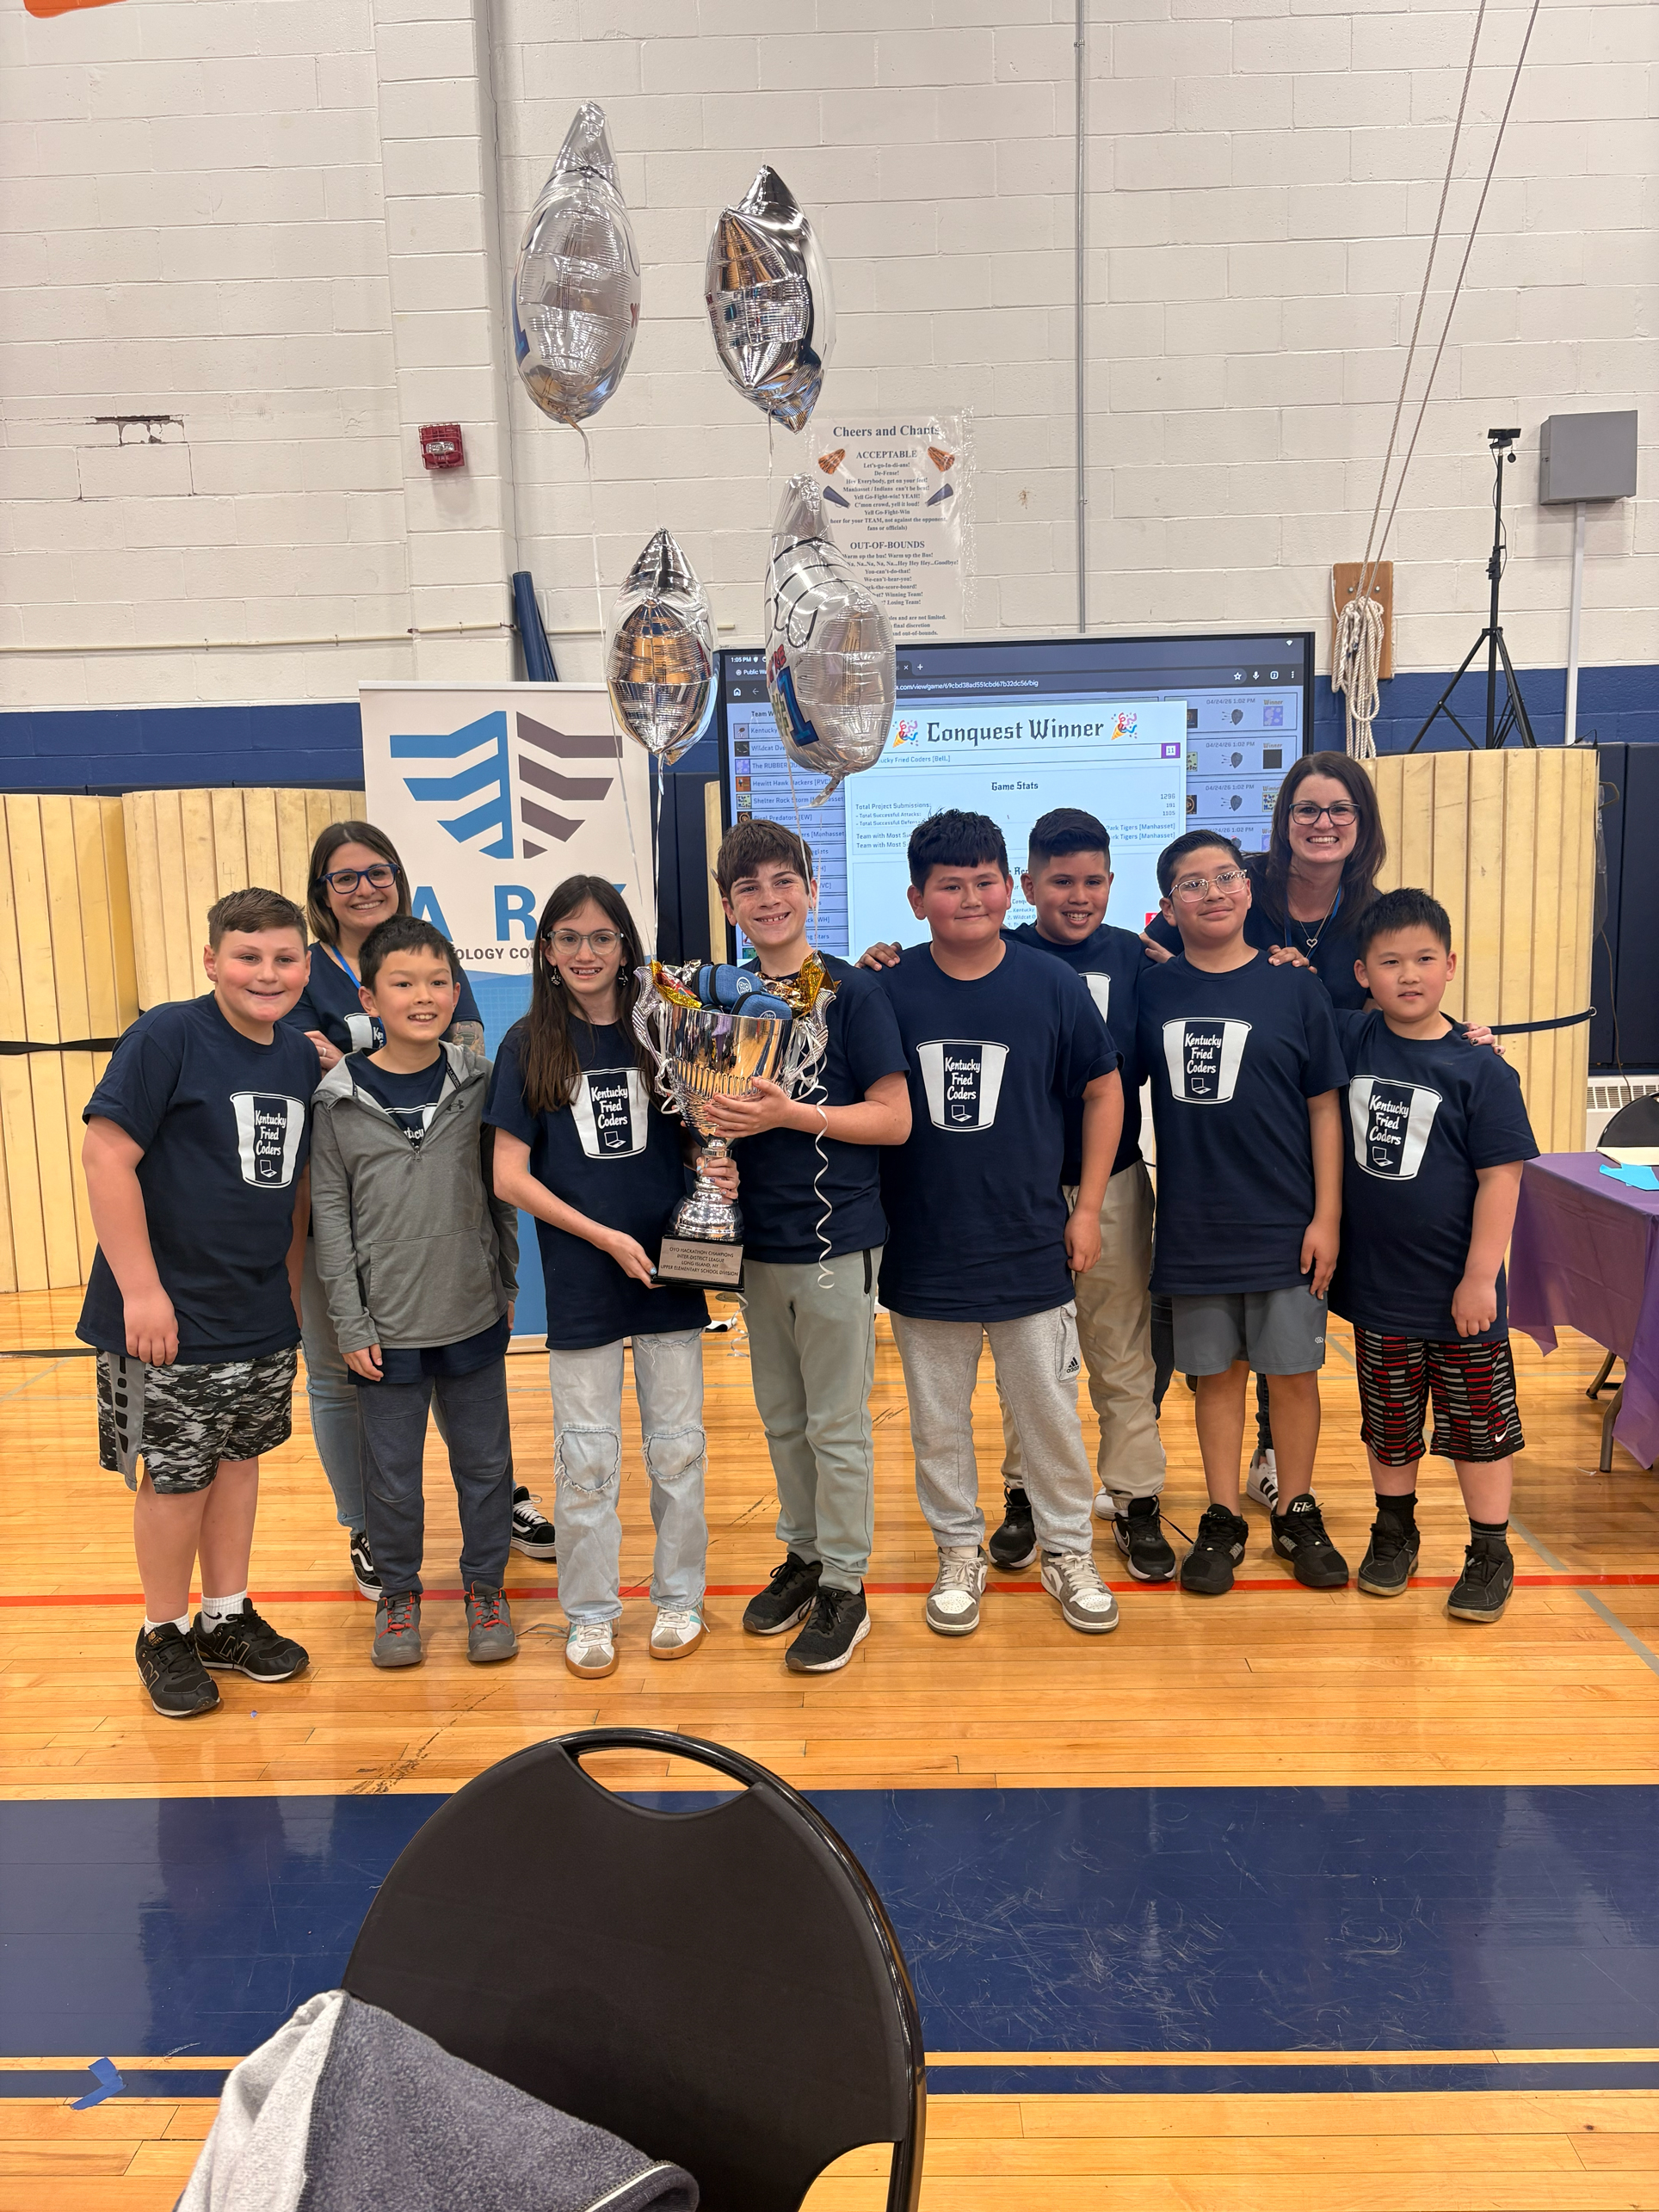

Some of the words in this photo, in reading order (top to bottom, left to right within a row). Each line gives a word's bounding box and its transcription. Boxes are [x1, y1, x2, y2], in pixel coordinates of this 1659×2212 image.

[833, 427, 873, 437] Cheers
[876, 426, 897, 436] and
[900, 425, 940, 435] Chants
[856, 450, 917, 459] ACCEPTABLE
[927, 721, 1023, 746] Conquest
[1029, 718, 1105, 741] Winner
[991, 782, 1015, 792] Game
[1016, 781, 1039, 790] Stats
[1185, 1033, 1222, 1048] Kentucky
[1191, 1047, 1212, 1060] Fried
[945, 1057, 980, 1073] Kentucky
[1187, 1060, 1216, 1074] Coders
[952, 1073, 973, 1085] Fried
[591, 1085, 628, 1101] Kentucky
[947, 1086, 977, 1100] Coders
[600, 1099, 622, 1113] Fried
[1370, 1094, 1409, 1118] Kentucky
[256, 1110, 287, 1128] Kentucky
[597, 1113, 627, 1129] Coders
[1376, 1112, 1399, 1130] Fried
[261, 1126, 279, 1140] Fried
[1369, 1126, 1401, 1145] Coders
[256, 1140, 281, 1155] Coders
